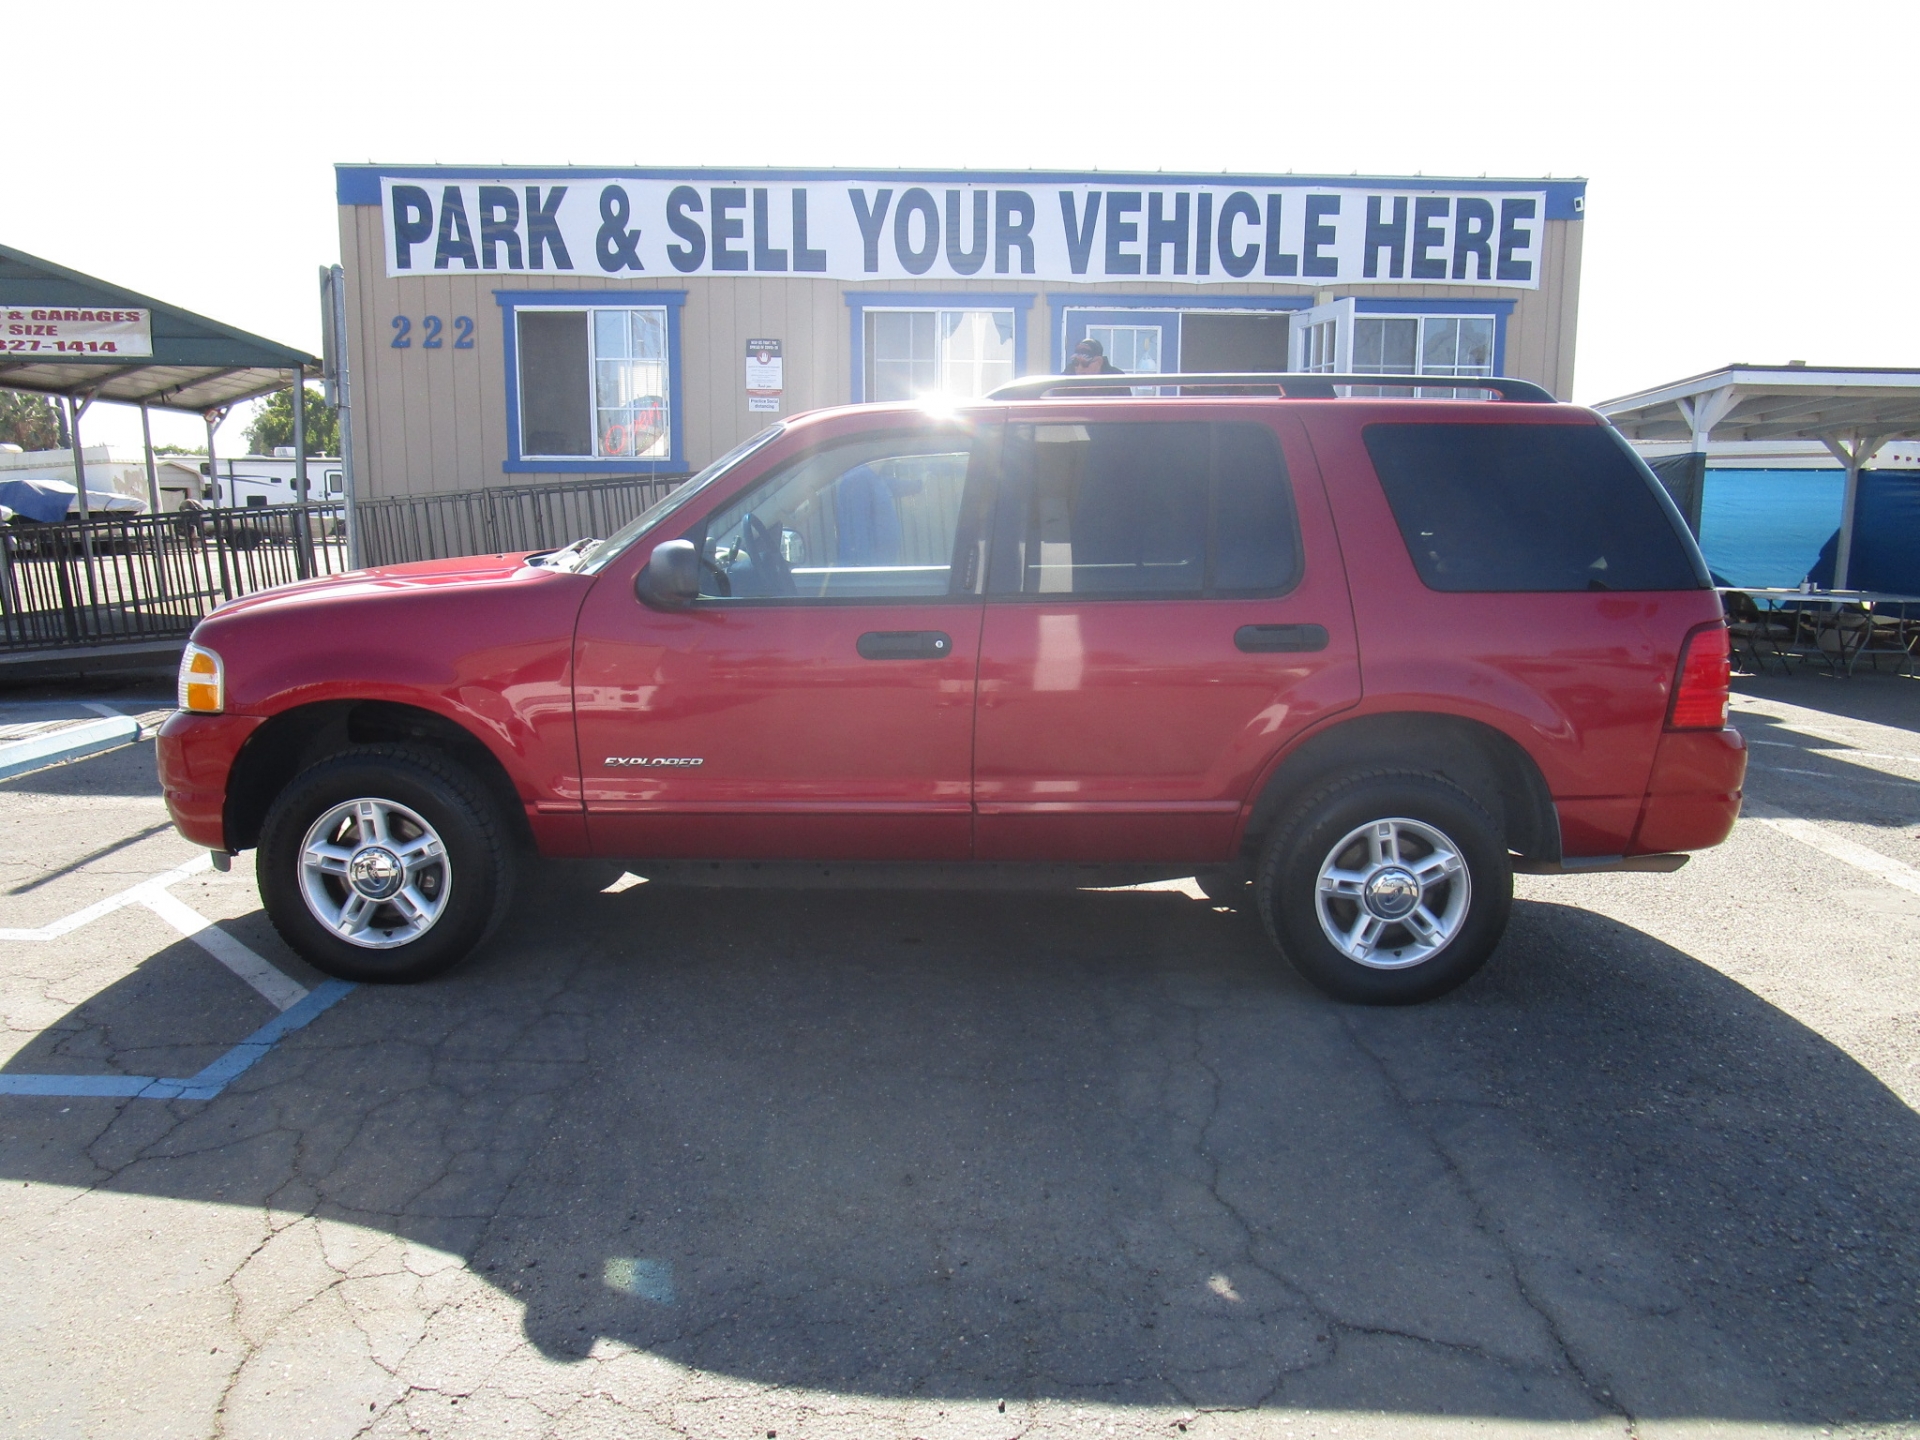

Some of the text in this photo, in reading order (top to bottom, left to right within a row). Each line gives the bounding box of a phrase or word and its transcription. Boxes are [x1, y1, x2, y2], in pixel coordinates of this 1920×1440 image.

[391, 184, 1537, 282] PARK & SELL YOUR VEHICLE HERE
[8, 310, 140, 322] & GARAGES
[9, 324, 58, 336] SIZE
[390, 314, 475, 350] 222
[603, 757, 704, 768] EXPLORER
